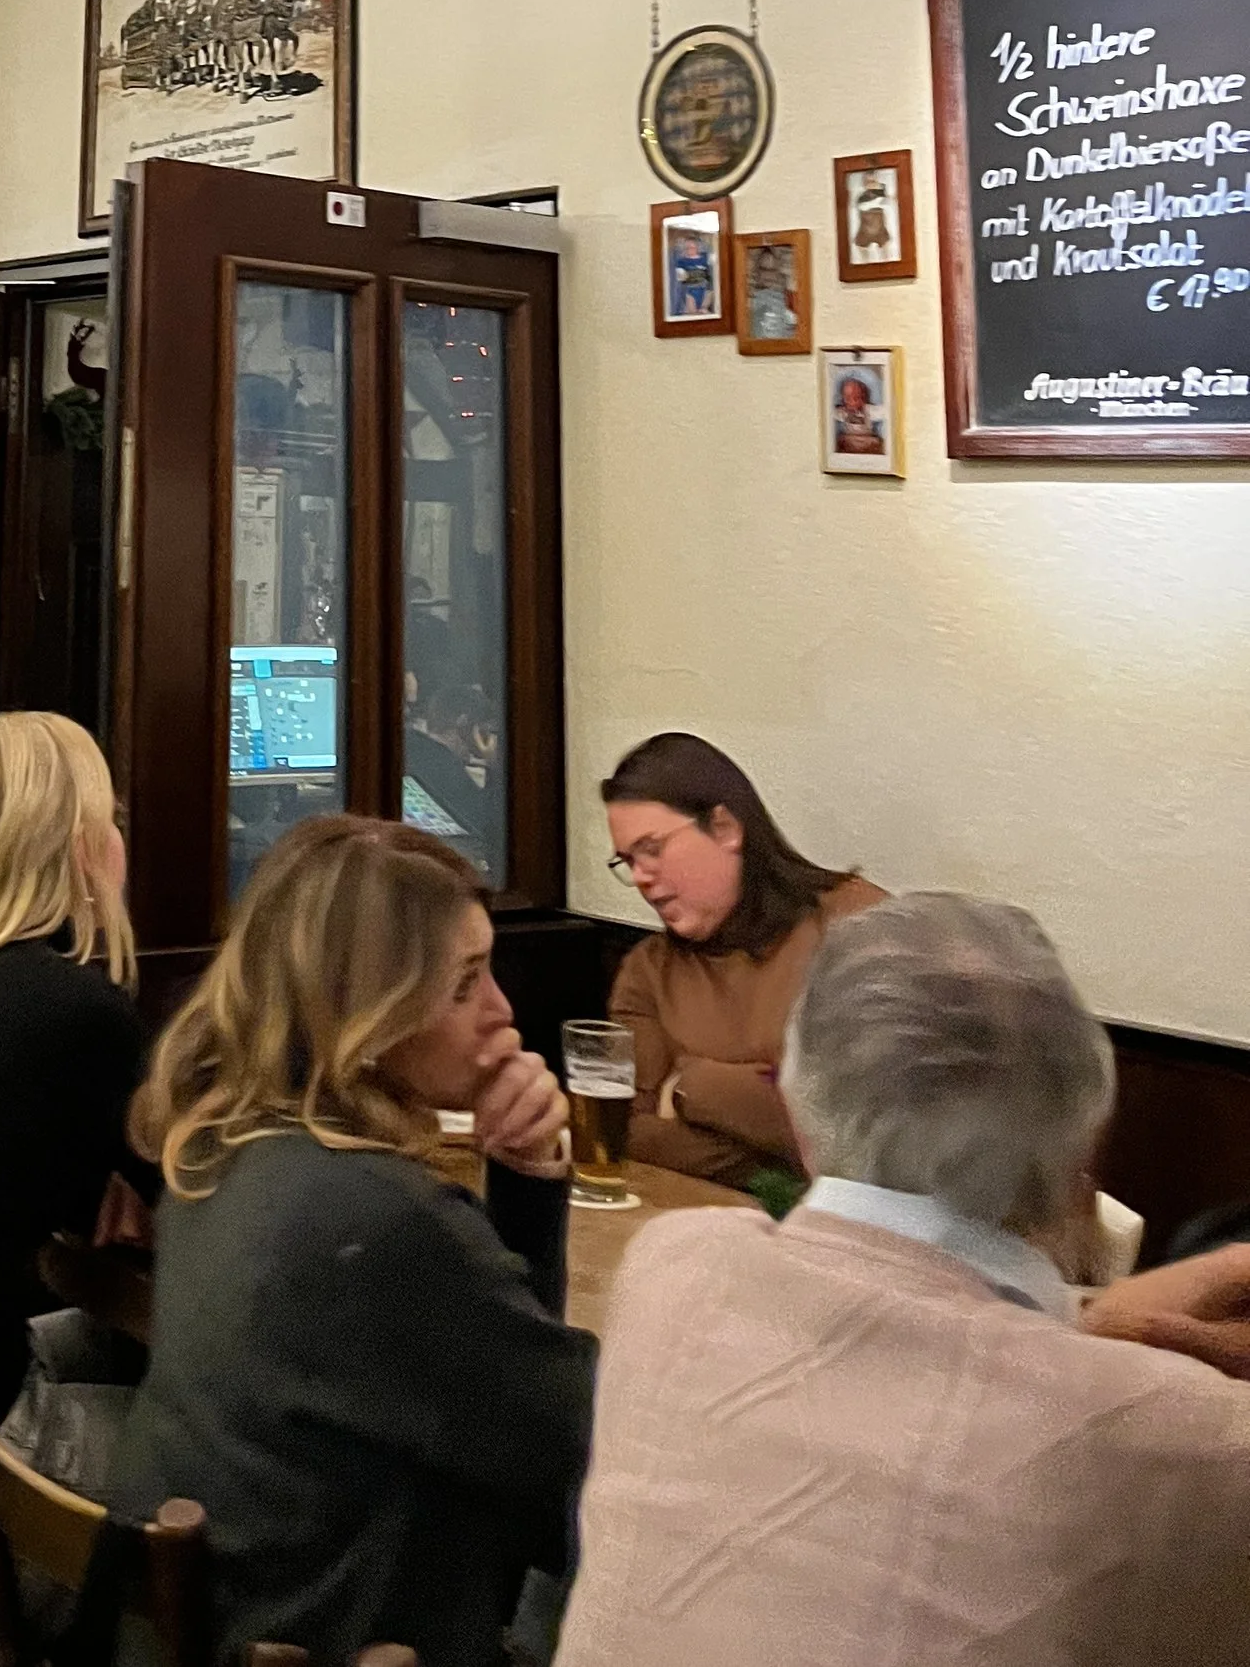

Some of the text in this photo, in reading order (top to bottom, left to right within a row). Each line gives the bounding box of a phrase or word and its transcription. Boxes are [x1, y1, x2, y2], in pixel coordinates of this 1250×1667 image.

[990, 23, 1156, 83] 1/2 hintere
[994, 64, 1246, 136] Schweinshaxe
[981, 121, 1250, 189] an Dunkelbiersoße
[982, 204, 1030, 237] mit
[991, 229, 1205, 283] und Krautsalat
[1146, 278, 1176, 312] €
